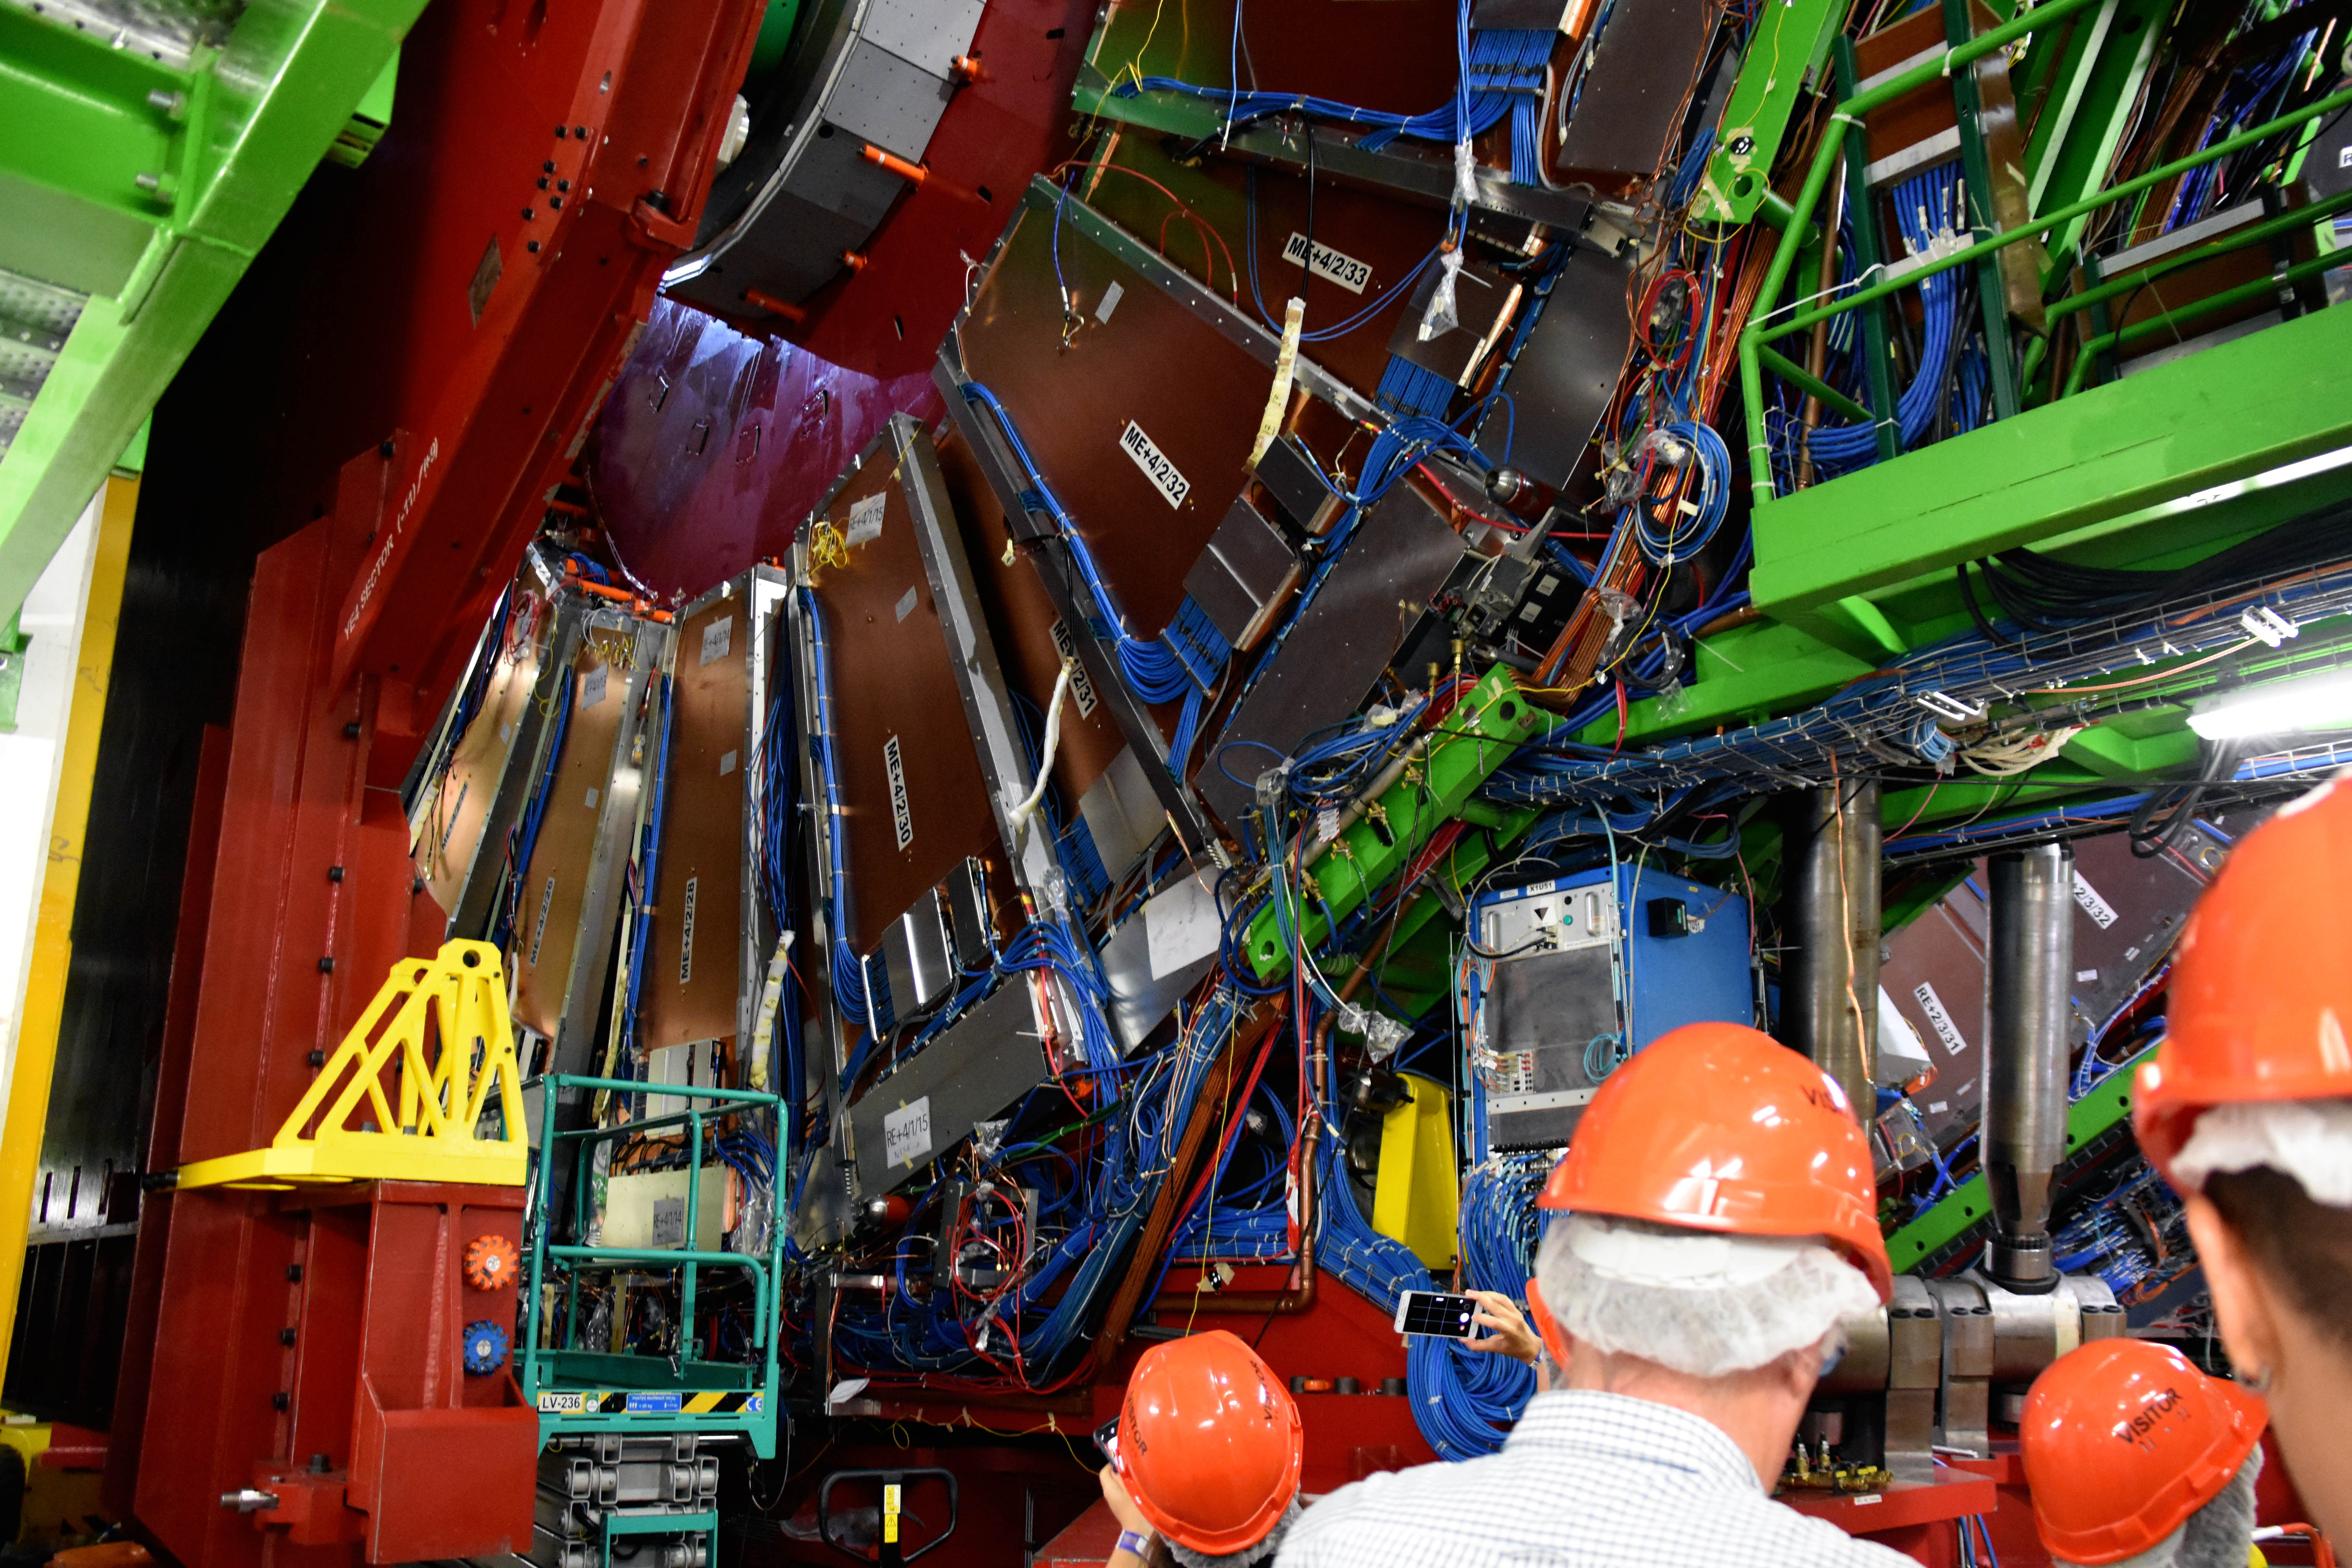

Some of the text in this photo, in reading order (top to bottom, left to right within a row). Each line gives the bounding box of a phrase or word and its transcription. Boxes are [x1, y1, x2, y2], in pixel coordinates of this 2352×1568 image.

[1125, 425, 1186, 502] ME+4/2/32
[361, 534, 394, 608] SECTOR
[887, 741, 911, 843] ME+4/2/30
[531, 880, 553, 964] ME+4/2/26
[1530, 883, 1552, 892] X1U51
[681, 881, 695, 979] ME+4/2/28
[1917, 987, 1959, 1051] RE+2/3/31
[887, 1114, 928, 1148] RE+4/1/15
[543, 1396, 580, 1409] LV-236
